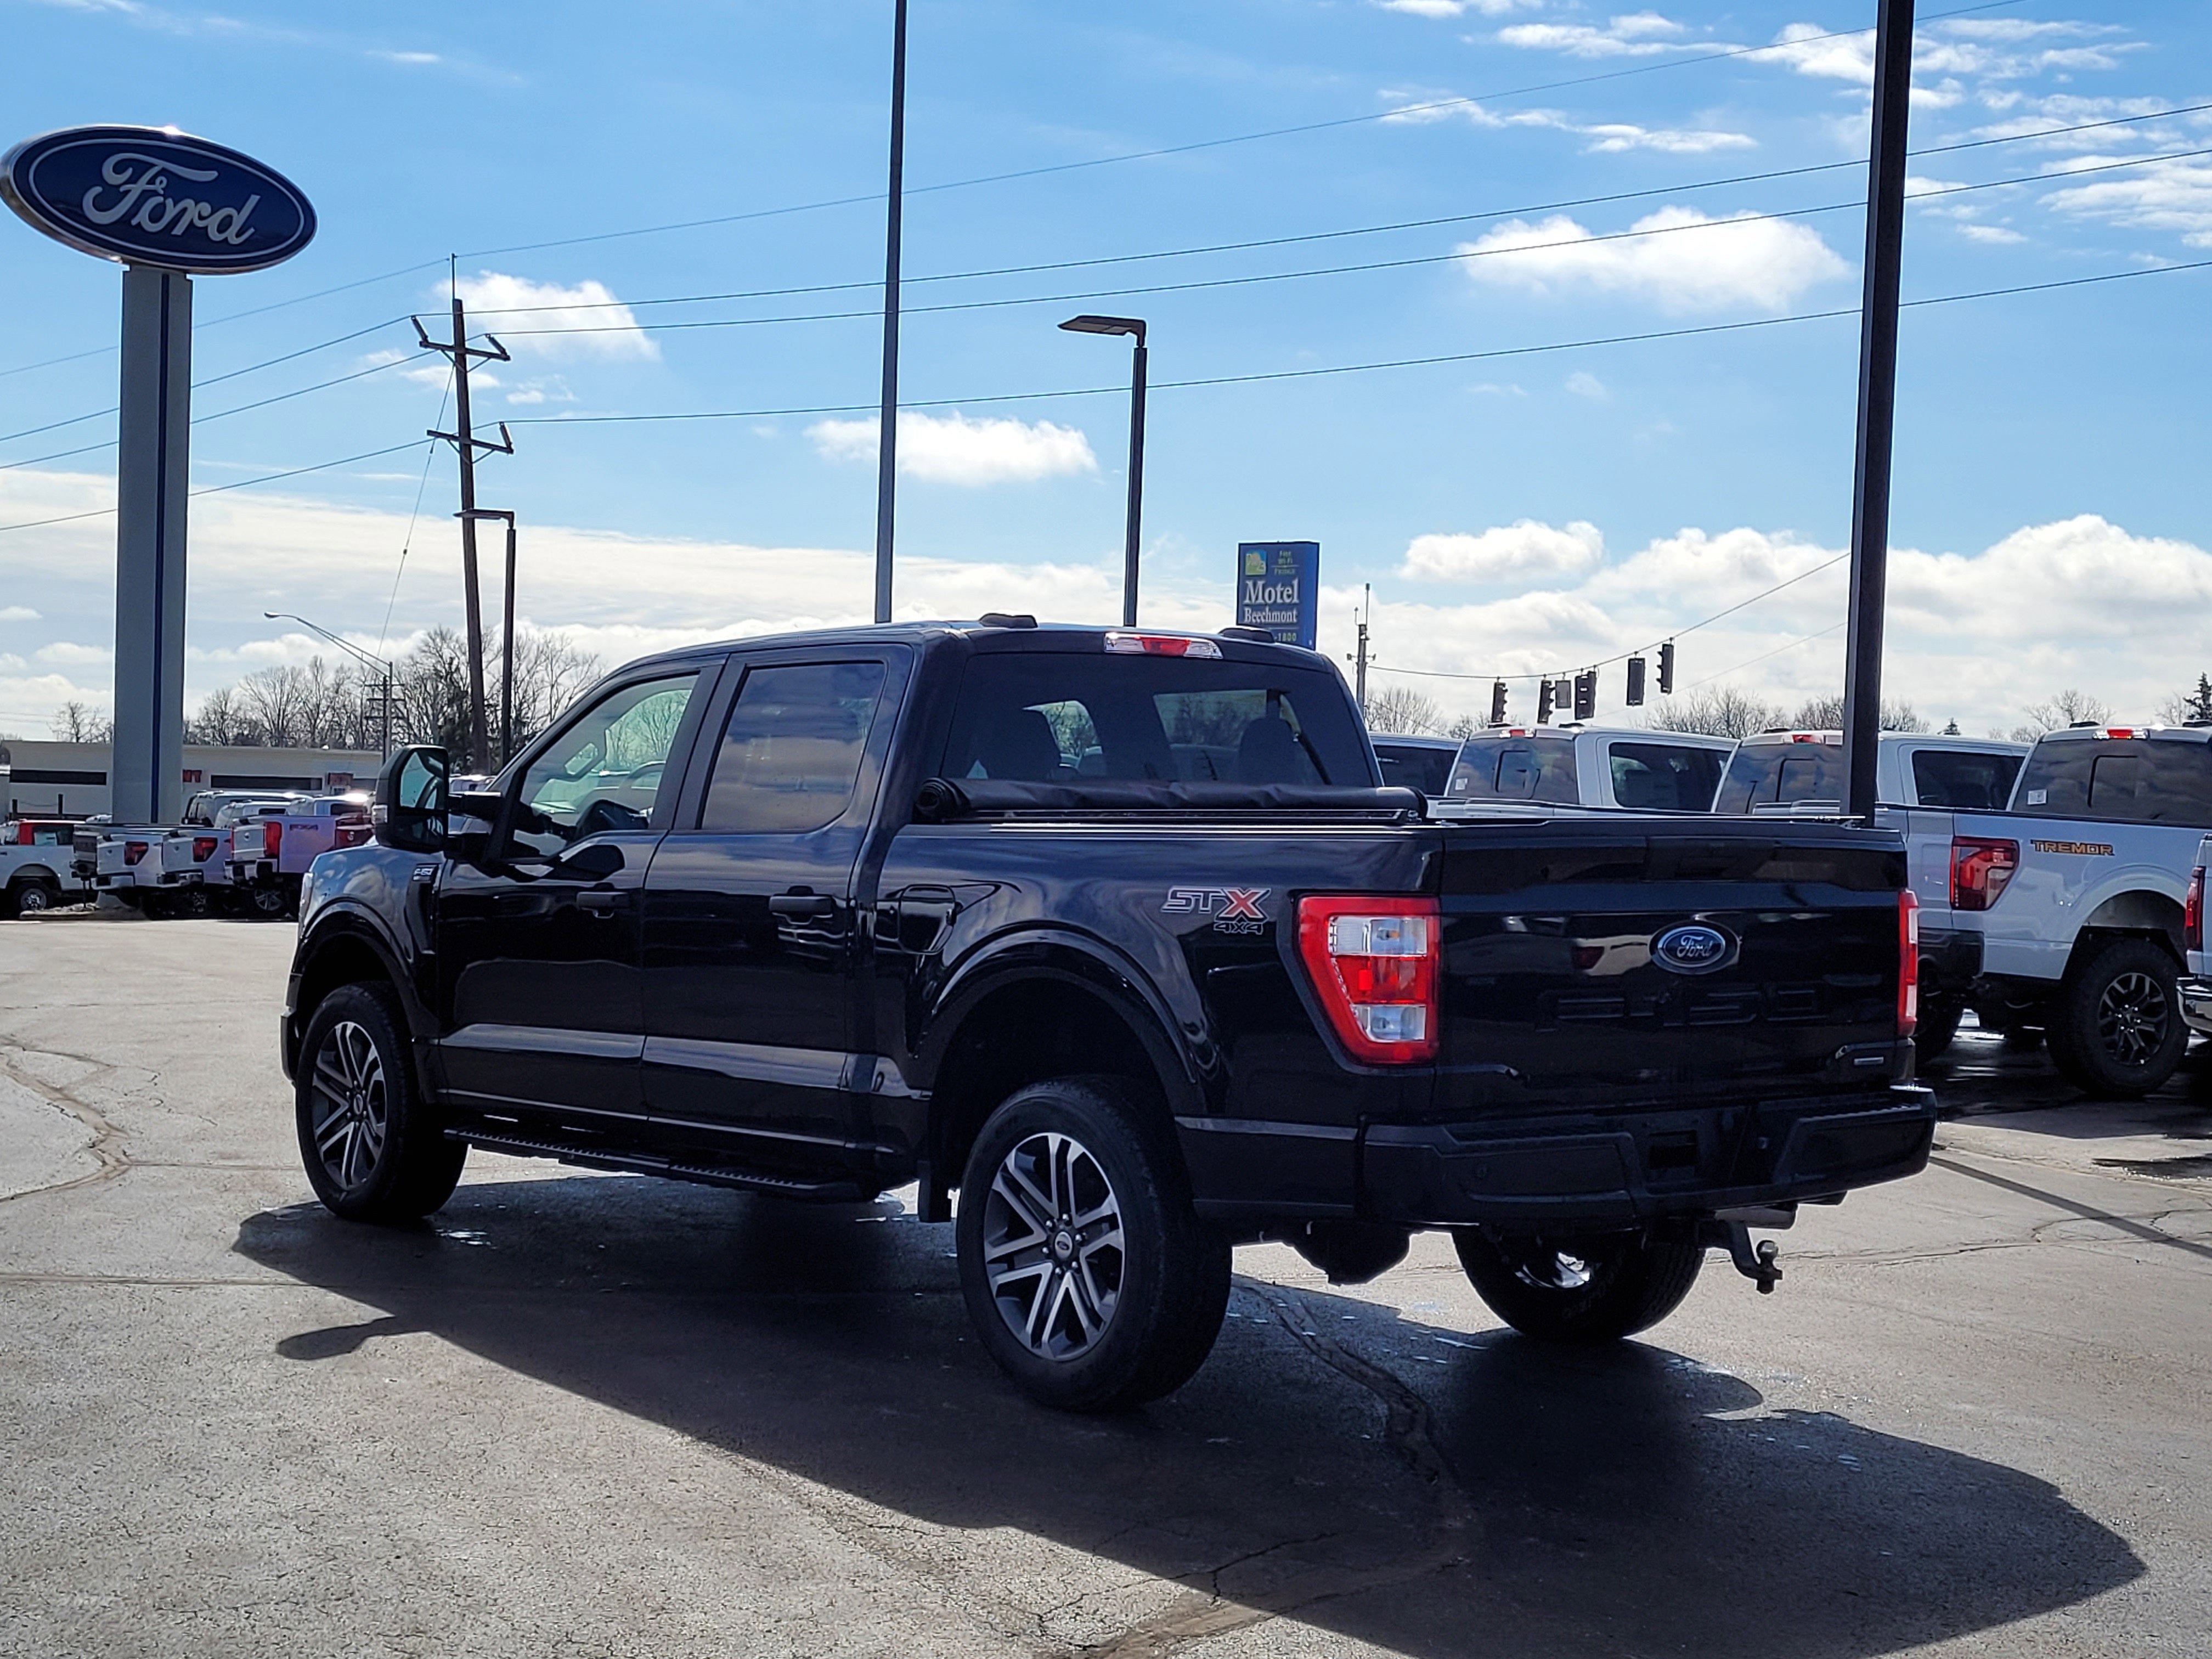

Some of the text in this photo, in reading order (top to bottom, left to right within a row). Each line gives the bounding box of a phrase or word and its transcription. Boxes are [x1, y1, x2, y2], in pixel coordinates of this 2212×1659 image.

[82, 153, 261, 245] Ford
[1243, 577, 1300, 604] Motel
[1244, 606, 1297, 624] Beechmont
[2030, 839, 2115, 856] TREMOR
[1160, 885, 1272, 922] STX
[1677, 934, 1714, 958] Ford
